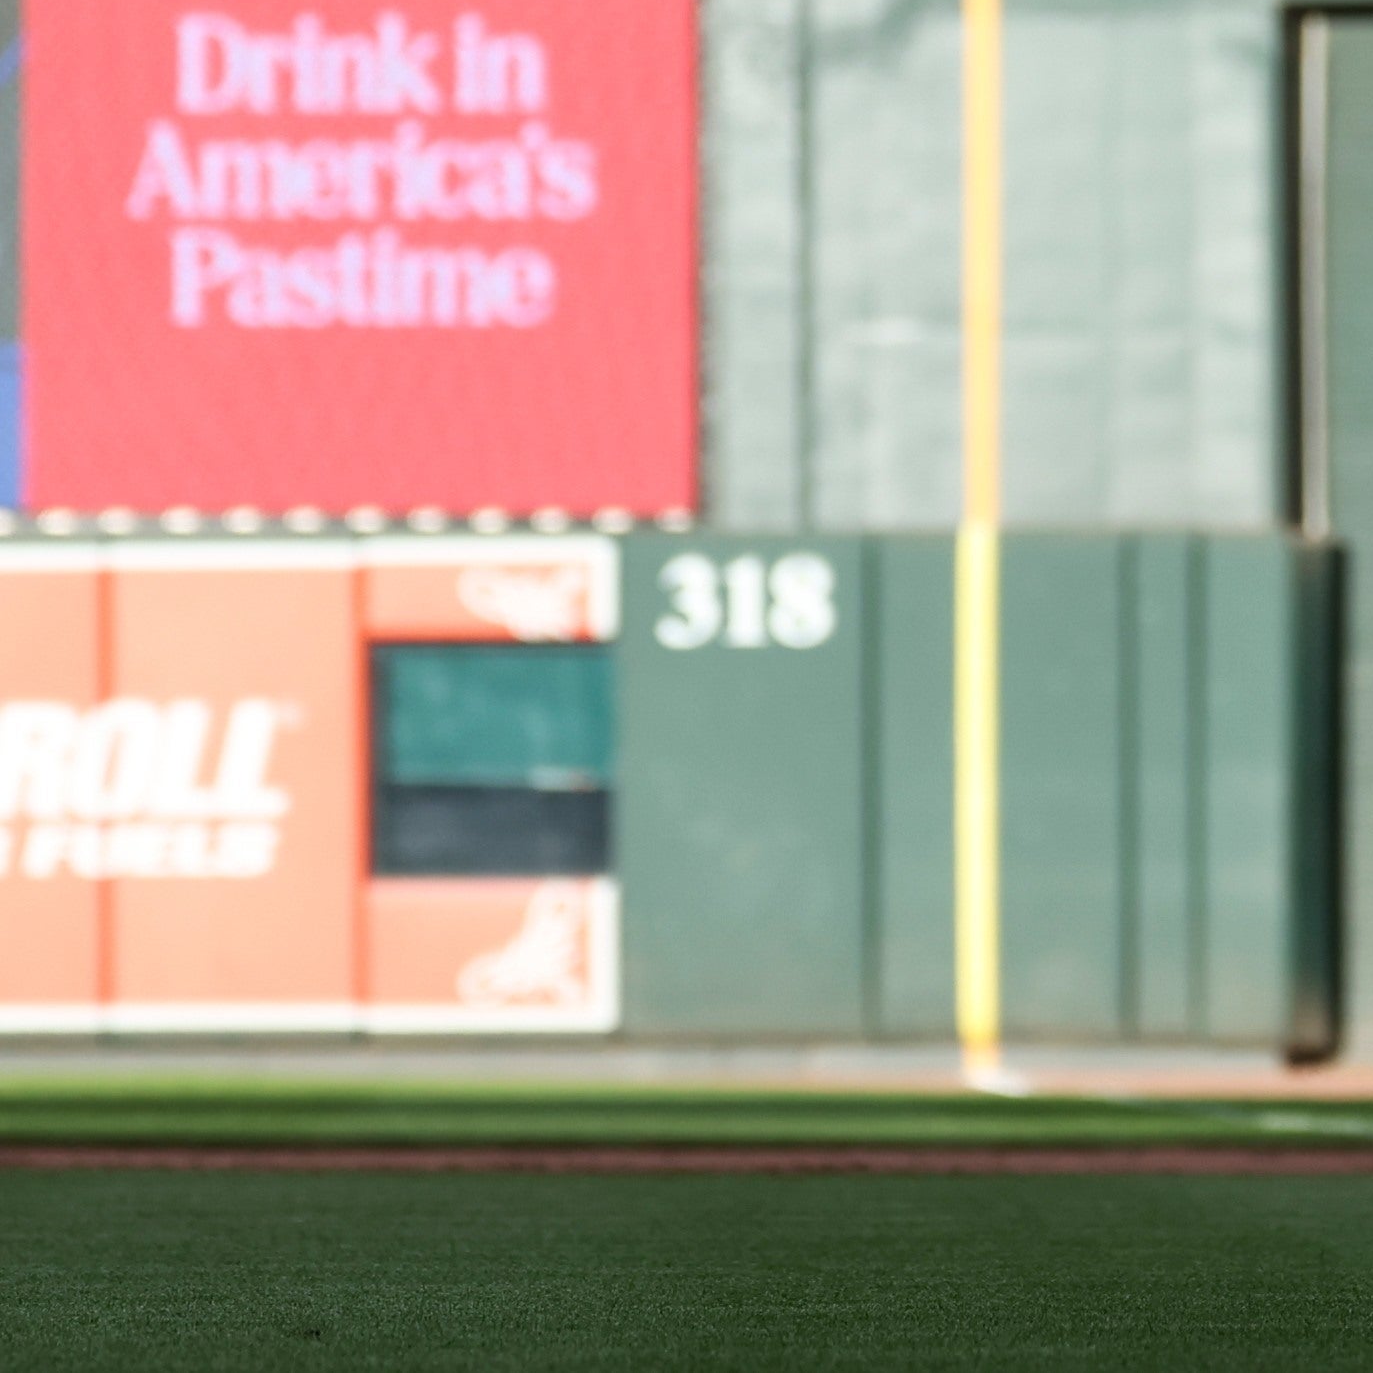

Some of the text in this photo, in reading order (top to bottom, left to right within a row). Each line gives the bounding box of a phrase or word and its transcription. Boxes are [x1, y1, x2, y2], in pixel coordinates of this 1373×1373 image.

[175, 11, 548, 115] Drink in
[126, 118, 598, 221] America's
[170, 228, 557, 328] Pastime
[656, 554, 836, 649] 318
